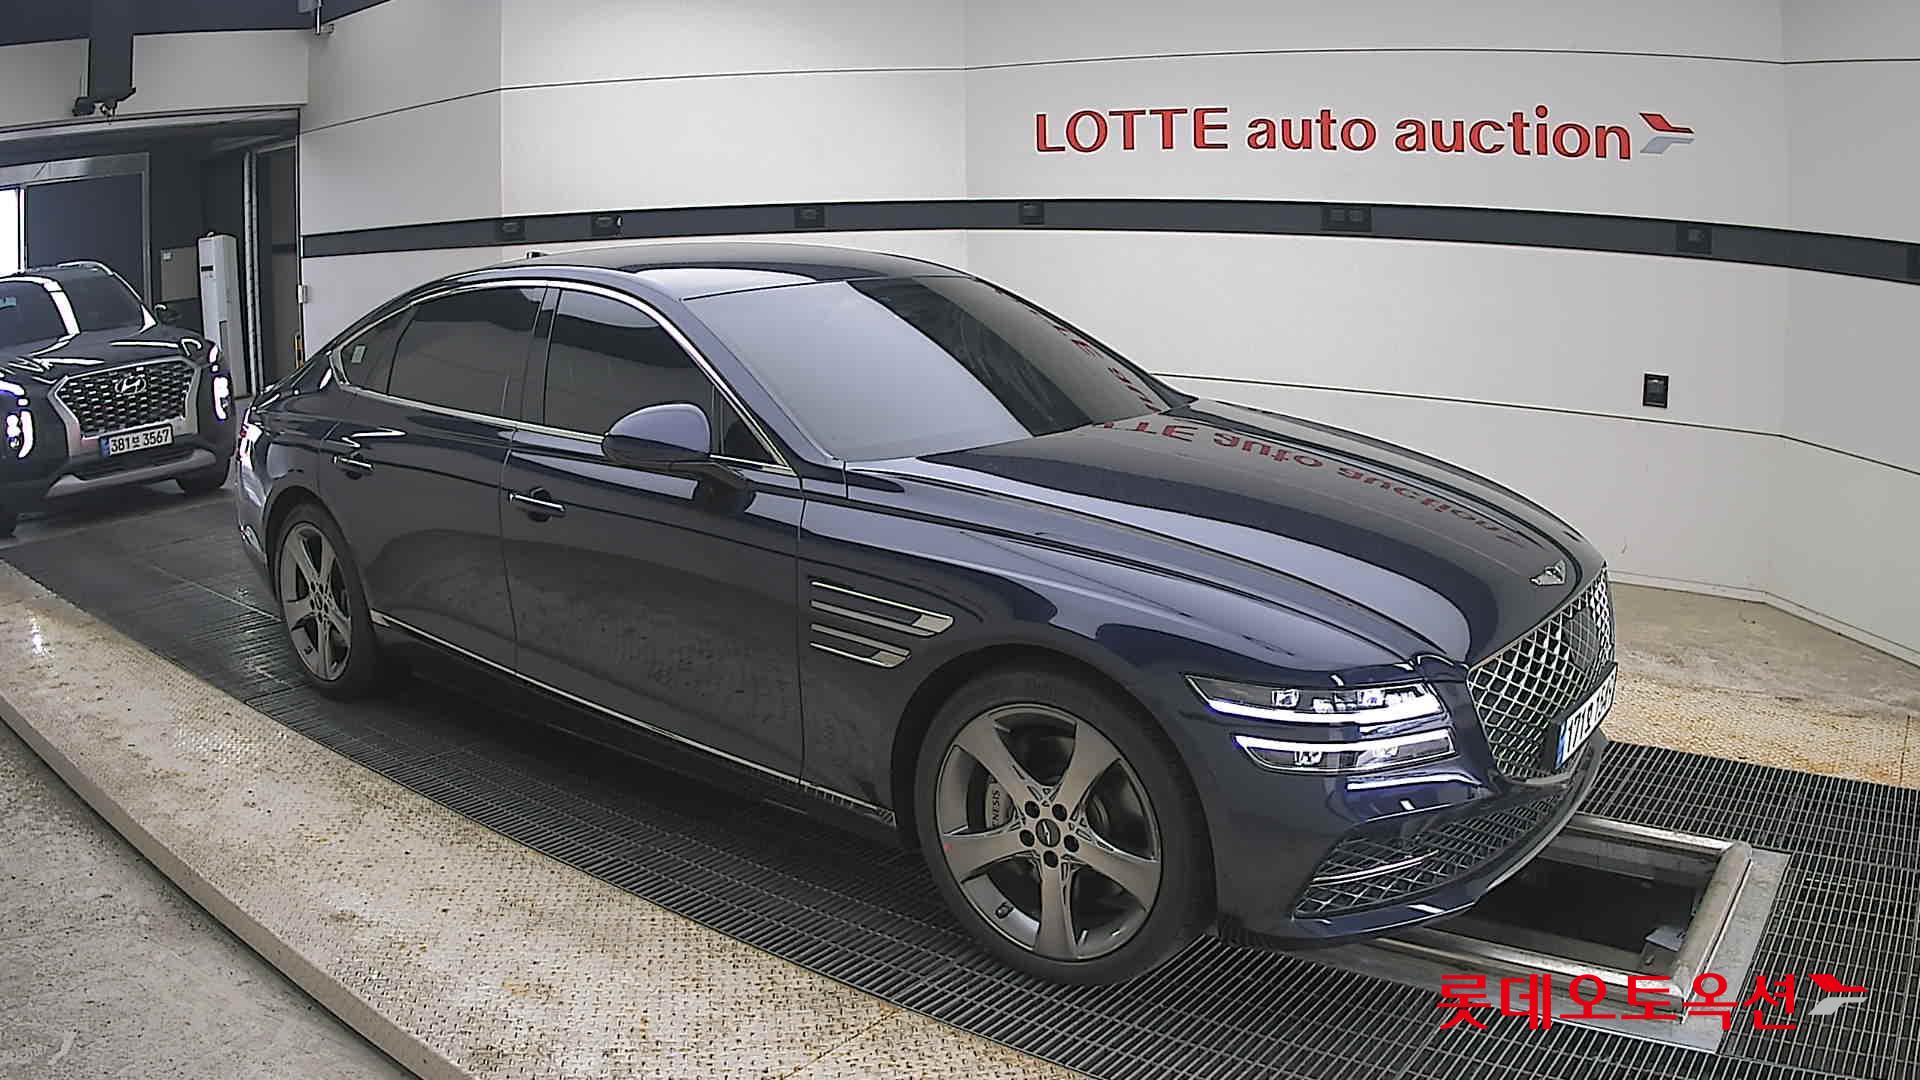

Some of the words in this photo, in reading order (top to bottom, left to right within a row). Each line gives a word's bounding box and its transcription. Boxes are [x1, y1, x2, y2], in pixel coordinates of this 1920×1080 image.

[1036, 107, 1228, 153] LOTTE
[1247, 109, 1378, 151] auto
[1395, 105, 1632, 160] auction
[142, 428, 169, 446] 3567
